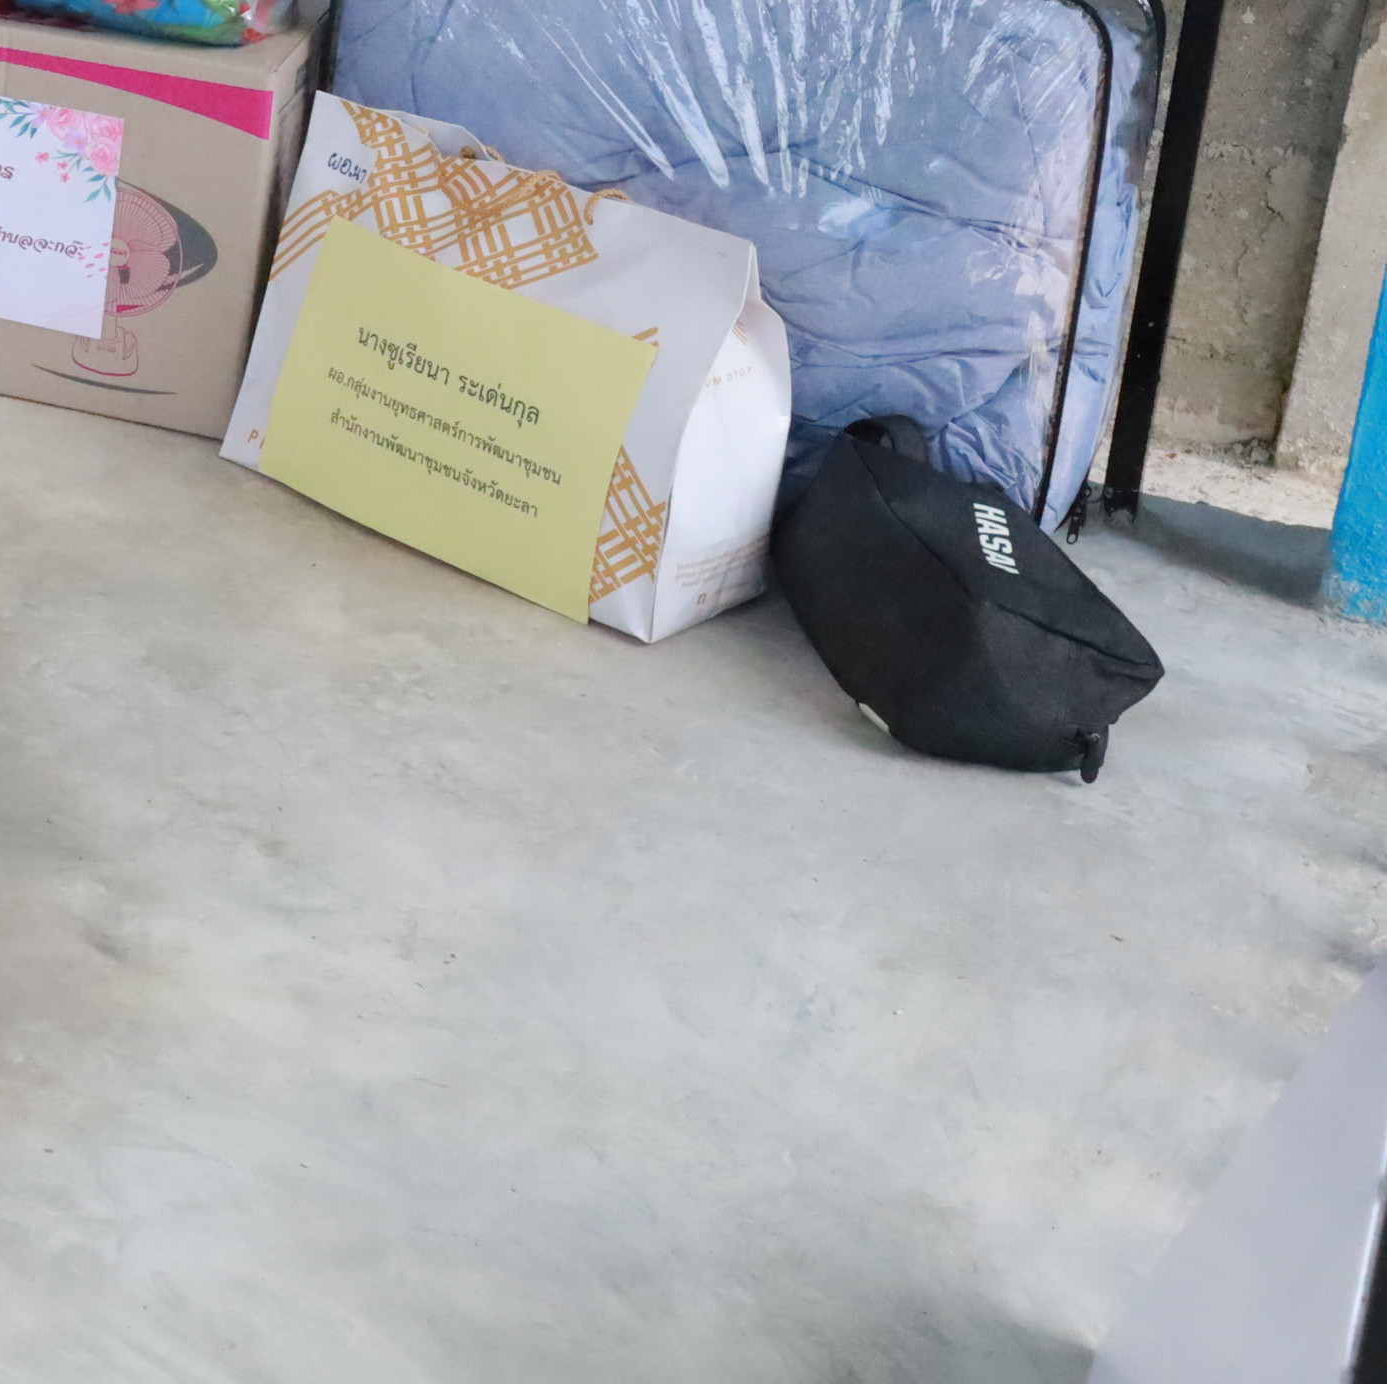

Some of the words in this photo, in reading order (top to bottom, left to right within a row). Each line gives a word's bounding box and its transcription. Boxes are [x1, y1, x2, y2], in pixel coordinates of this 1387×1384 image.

[327, 366, 563, 485] ผอ.กลุ่มงานยุทธศาสตร์การพัฒนาชุมชน
[357, 325, 451, 386] นางซูเรียนา
[458, 374, 541, 429] ระเด่นกุล
[330, 407, 538, 518] สำนักงานพัฒนาชุมชนจังหวัดยะลา
